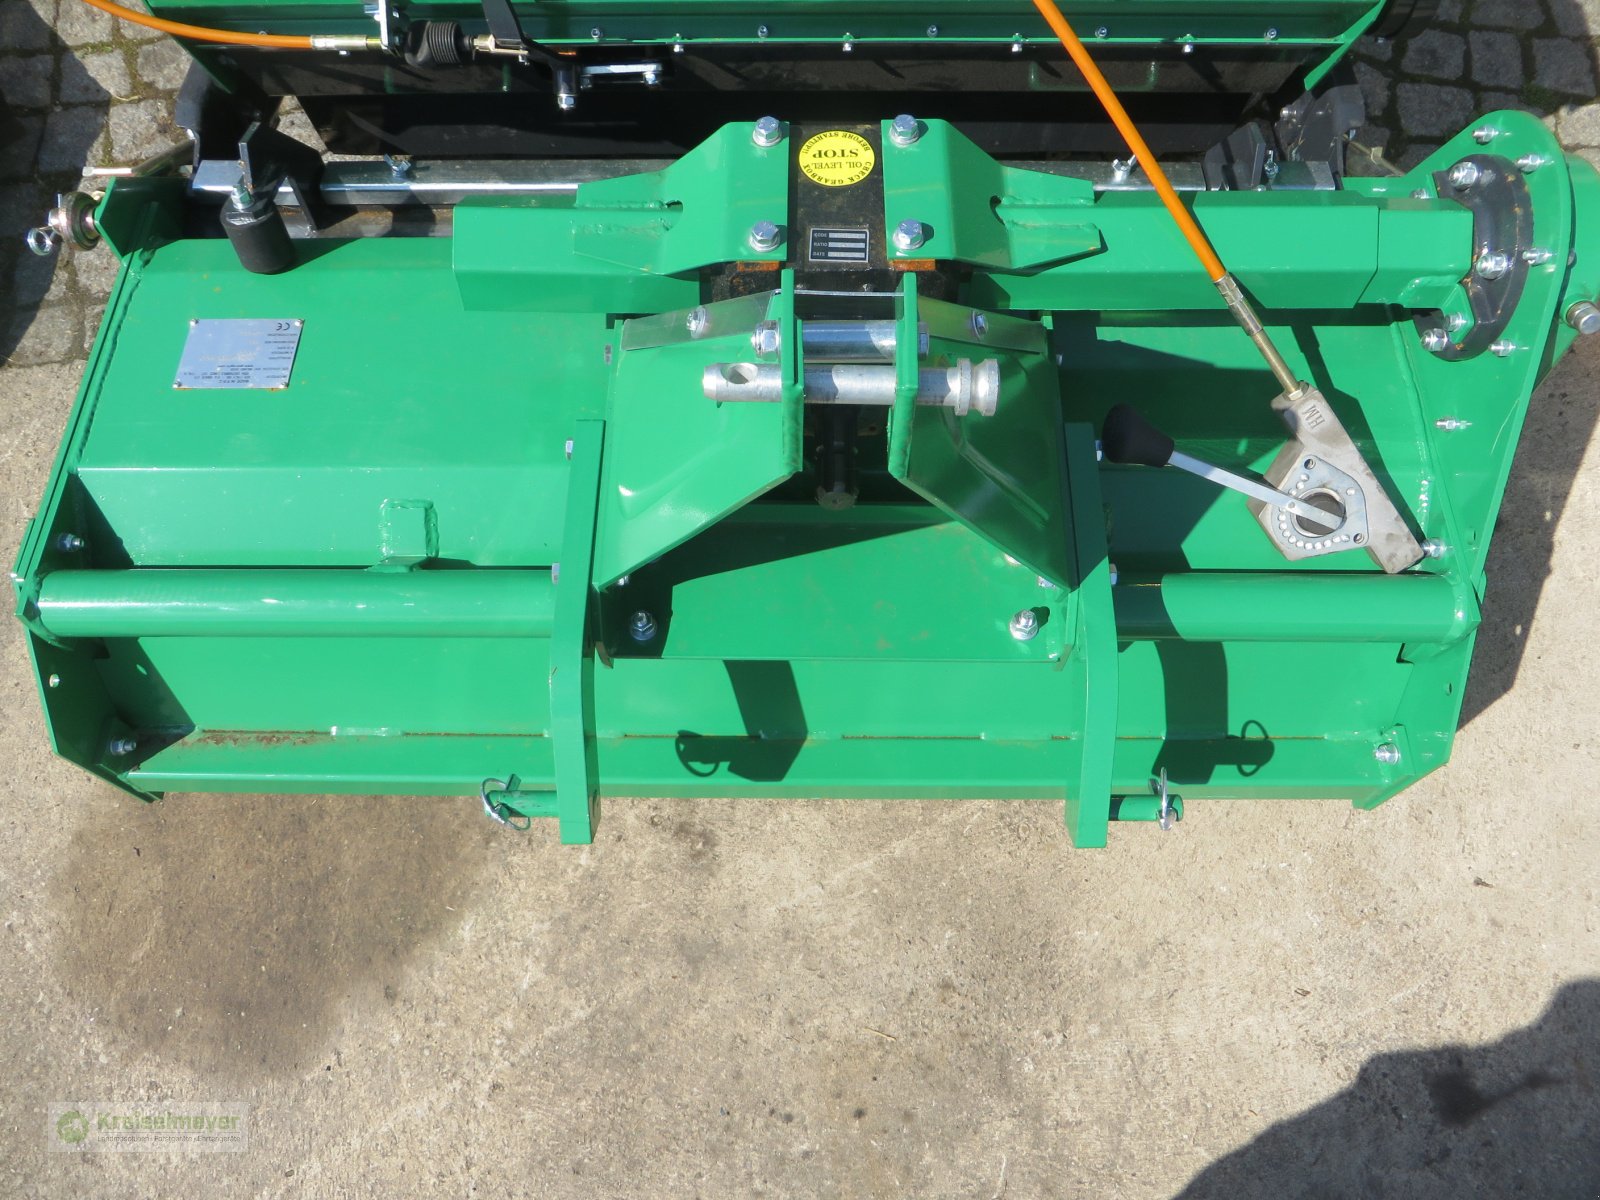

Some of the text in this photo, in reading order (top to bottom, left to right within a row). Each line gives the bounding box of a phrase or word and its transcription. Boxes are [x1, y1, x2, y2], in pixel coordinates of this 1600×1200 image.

[841, 131, 871, 152] BEFORE
[812, 148, 859, 159] STOP
[802, 161, 872, 185] CHECK GEARBOX
[811, 161, 863, 170] OIL LEVEL
